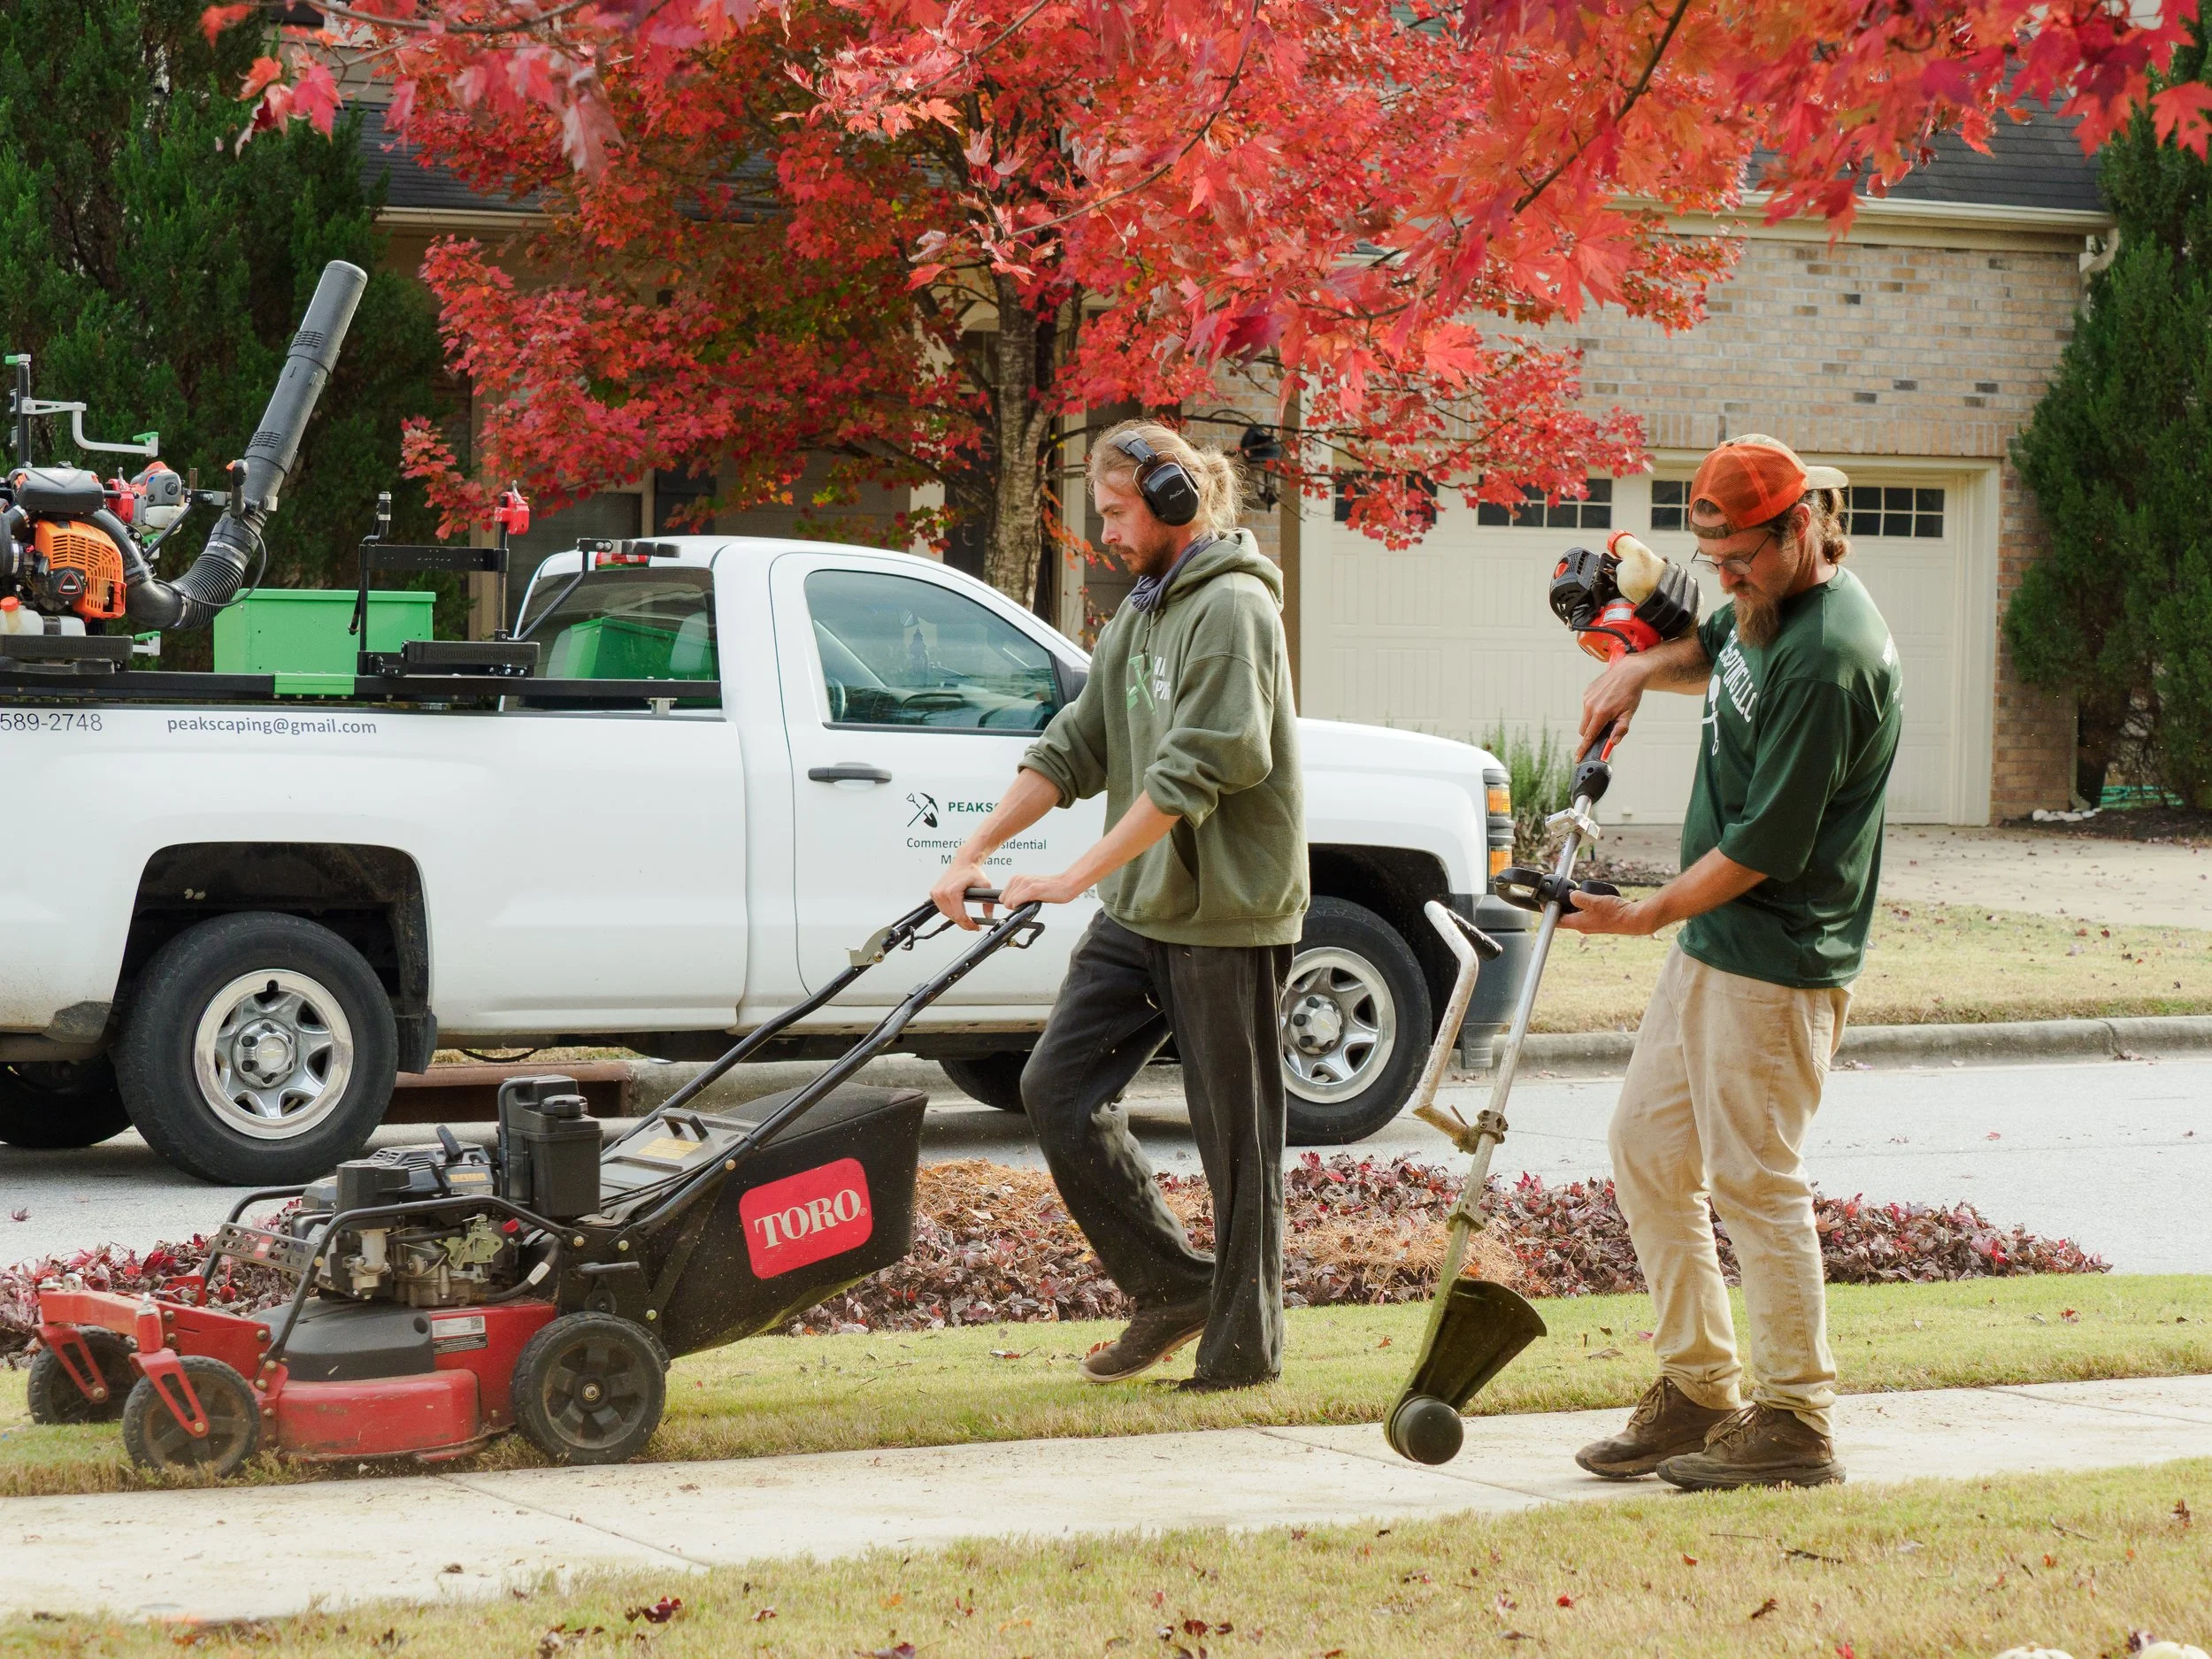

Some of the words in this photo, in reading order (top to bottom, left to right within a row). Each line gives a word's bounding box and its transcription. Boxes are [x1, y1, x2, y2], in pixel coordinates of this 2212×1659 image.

[0, 713, 103, 732] 589-2748
[167, 716, 377, 734] peakscaping@gmail.com
[949, 802, 998, 812] PEAKS
[907, 837, 966, 849] Commerci
[1001, 839, 1047, 849] sidential
[754, 1189, 862, 1249] TORO
